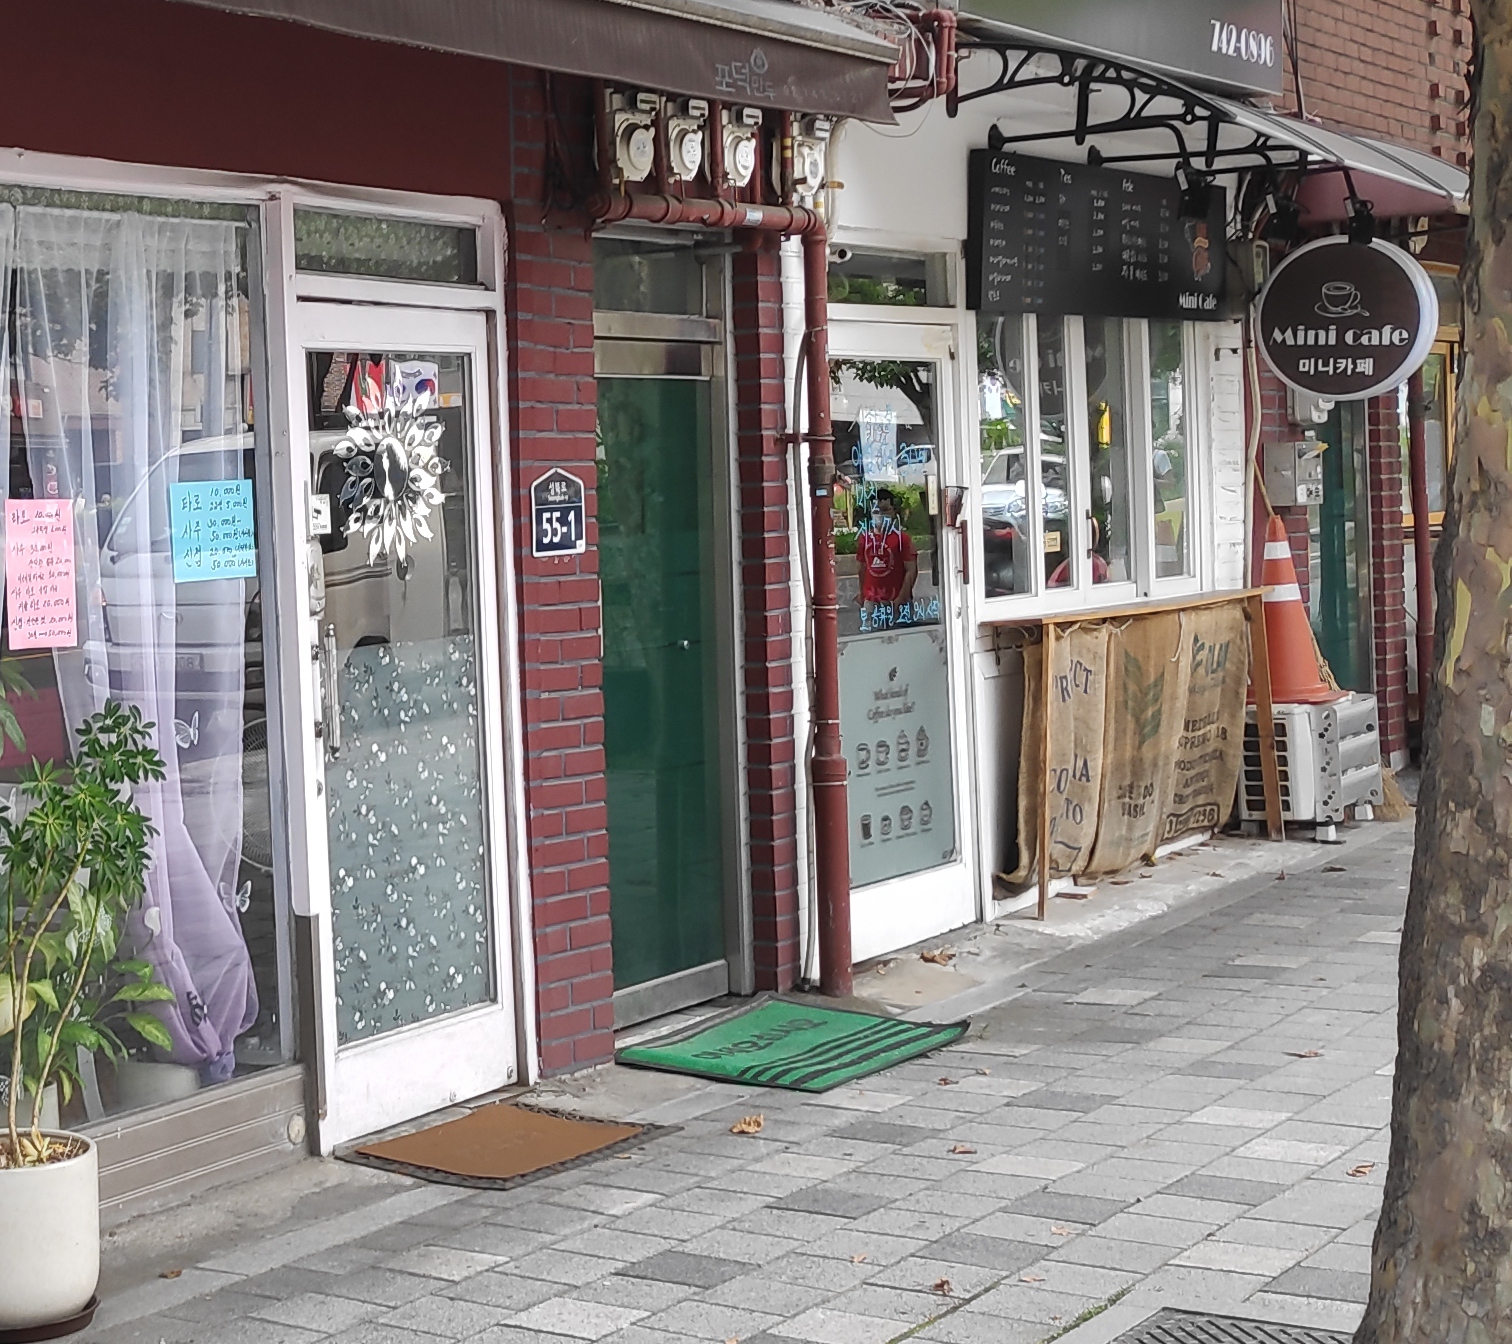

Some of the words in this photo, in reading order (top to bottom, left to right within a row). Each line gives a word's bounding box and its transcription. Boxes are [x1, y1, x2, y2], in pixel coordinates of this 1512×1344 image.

[1210, 19, 1276, 68] 742-0896
[1178, 291, 1198, 309] Mini
[1199, 292, 1217, 310] Cafe
[1269, 325, 1337, 346] Mini
[1344, 324, 1410, 346] cafe
[1298, 357, 1374, 376] 미니카페
[181, 490, 202, 512] 타로
[181, 519, 202, 542] 사주
[542, 510, 576, 544] 55-1
